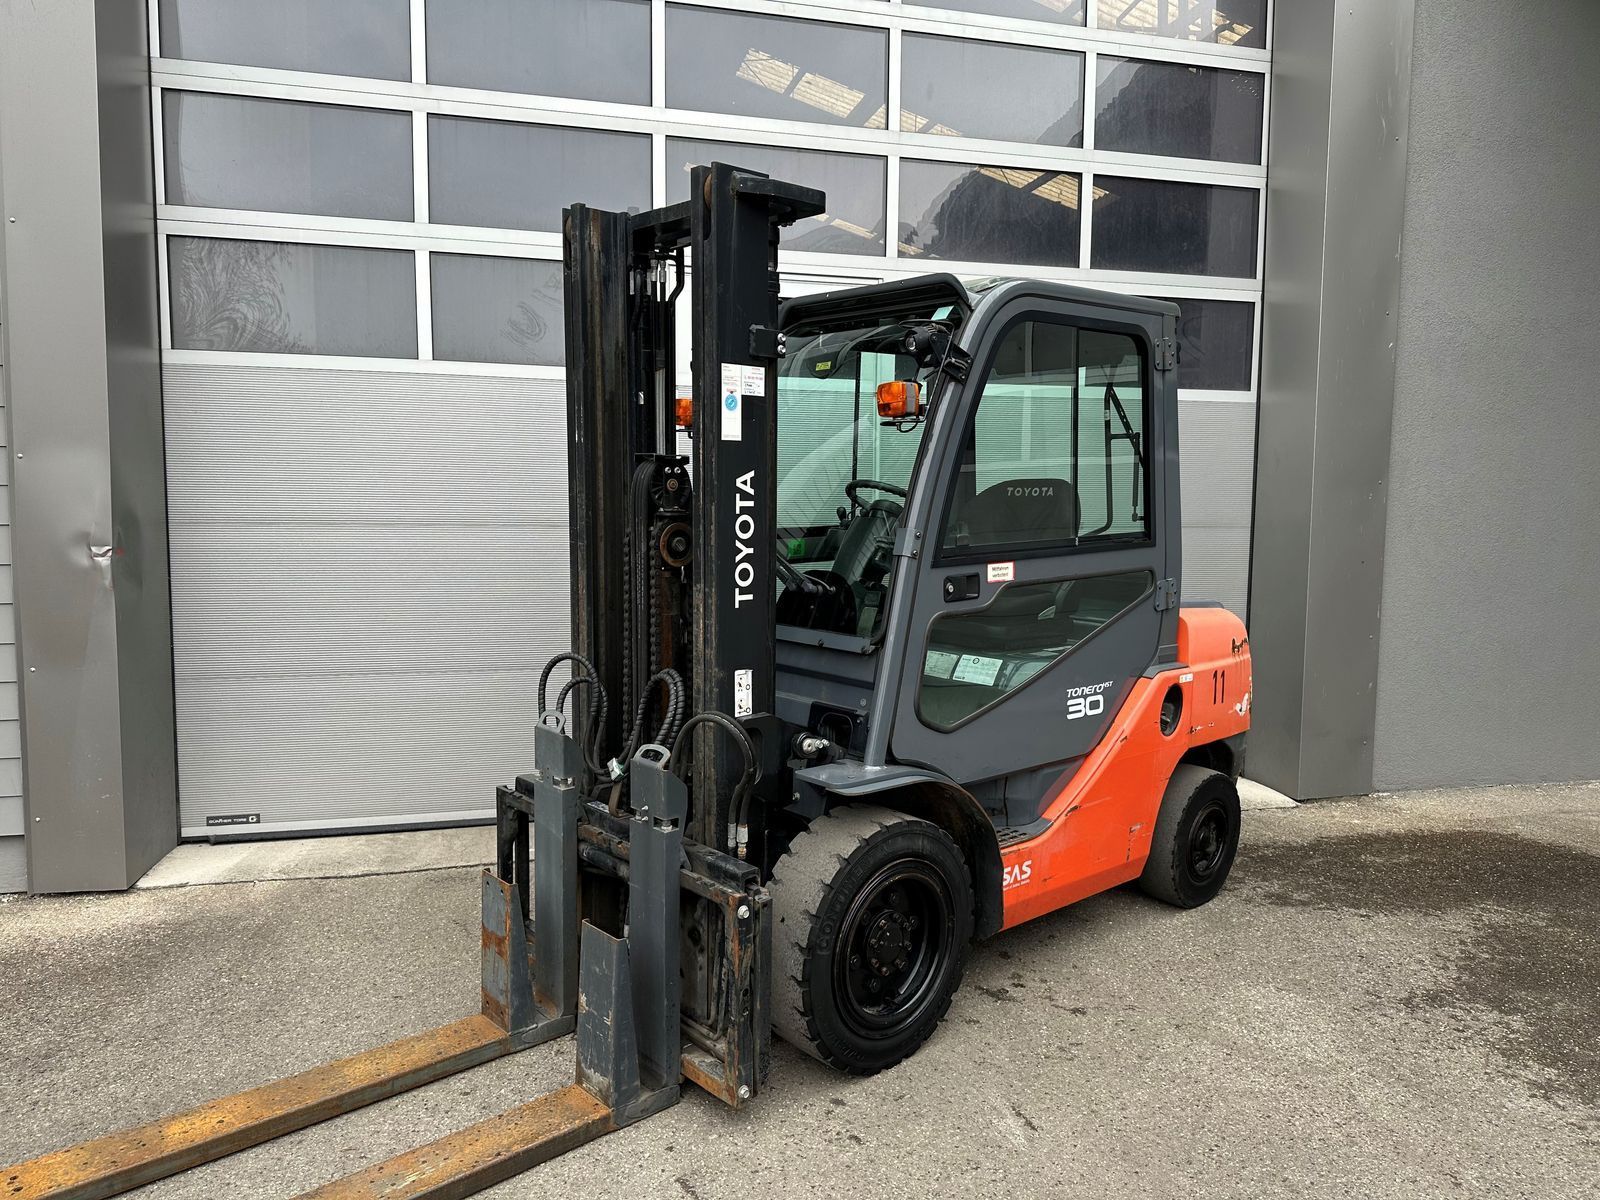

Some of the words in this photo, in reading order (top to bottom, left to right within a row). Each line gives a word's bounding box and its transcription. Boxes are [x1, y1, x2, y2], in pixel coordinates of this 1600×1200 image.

[1007, 487, 1054, 497] TOYOTA
[734, 469, 755, 609] TOYOTA
[1212, 669, 1226, 705] 11
[1066, 694, 1104, 720] 30
